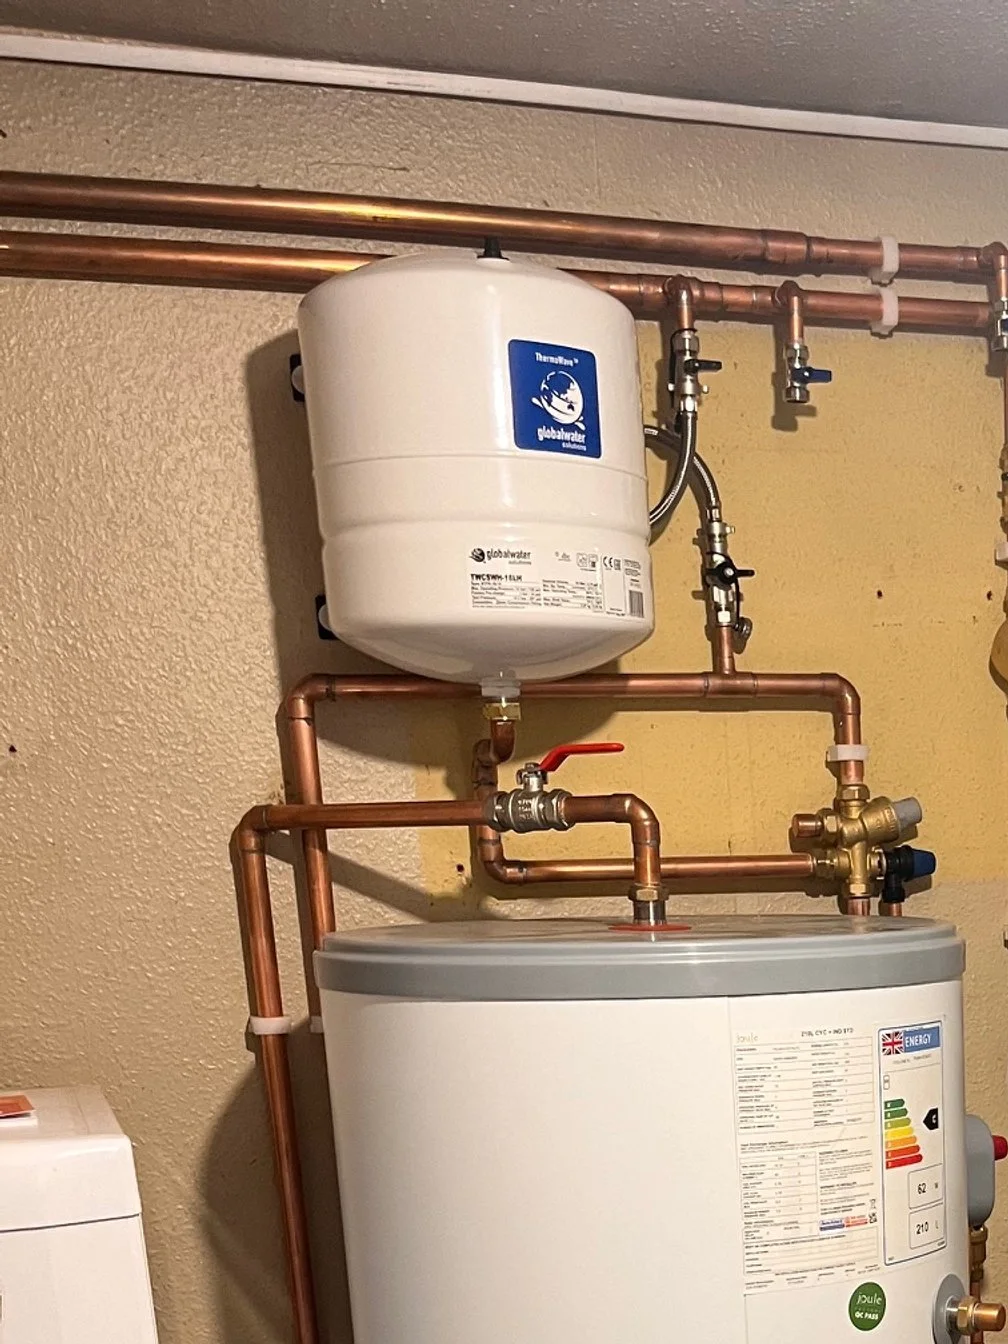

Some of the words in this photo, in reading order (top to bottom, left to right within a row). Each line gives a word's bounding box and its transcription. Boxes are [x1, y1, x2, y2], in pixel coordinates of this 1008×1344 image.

[537, 426, 585, 443] globalwater
[486, 548, 531, 561] globalwater
[905, 1033, 931, 1048] ENERGY
[917, 1182, 927, 1195] 62
[916, 1221, 929, 1235] 210
